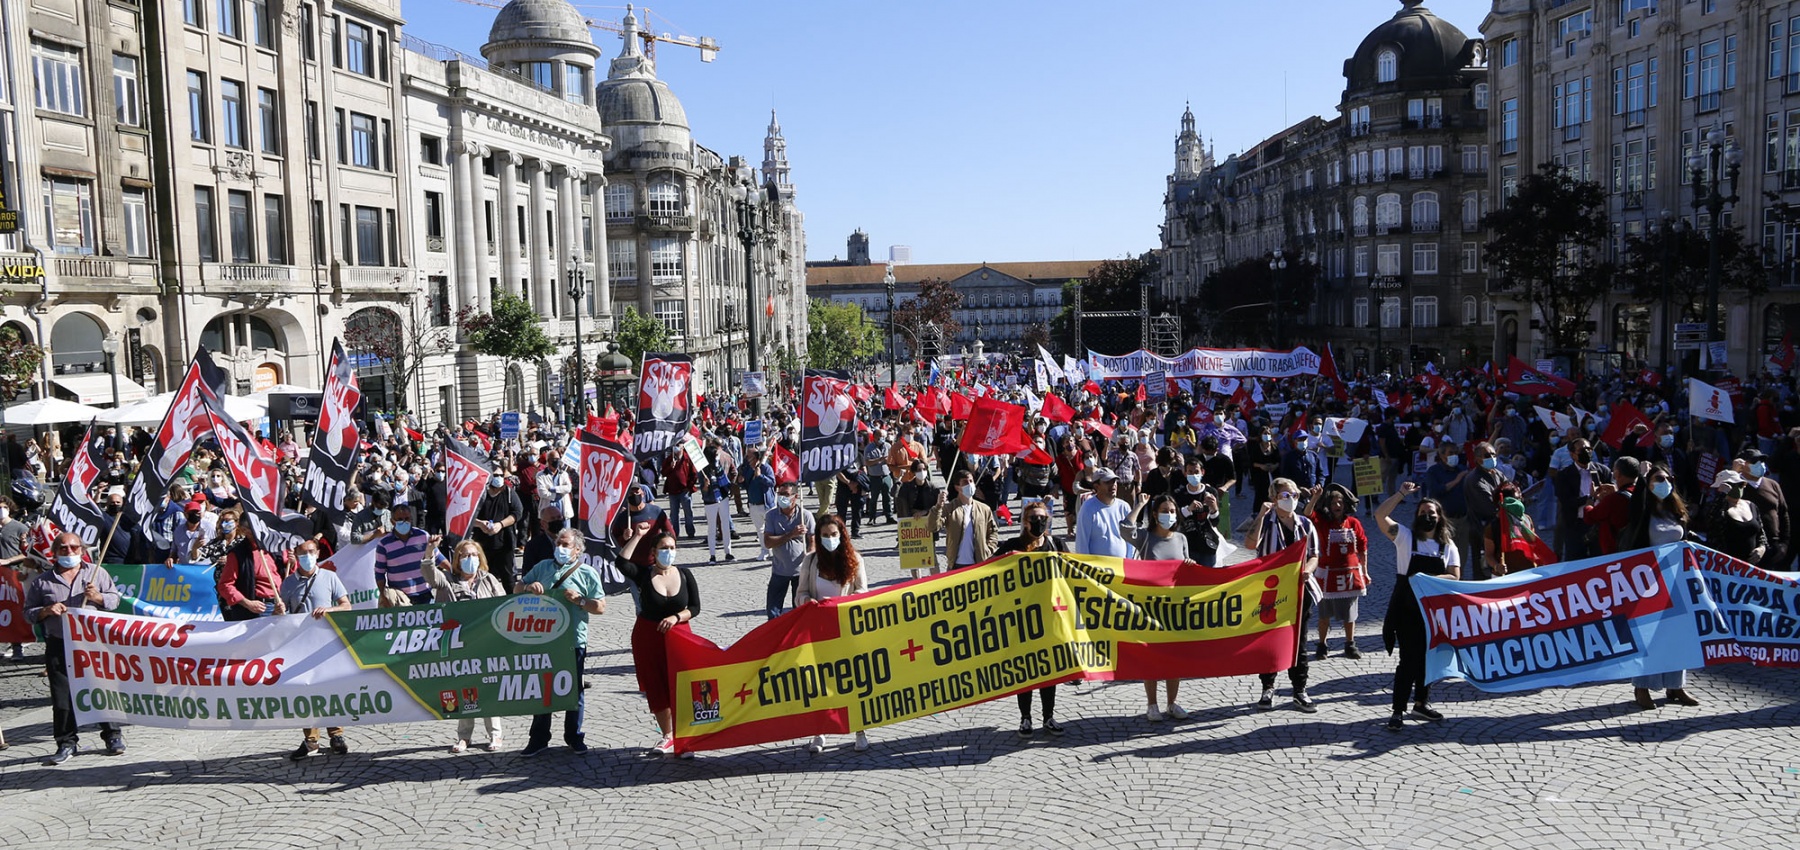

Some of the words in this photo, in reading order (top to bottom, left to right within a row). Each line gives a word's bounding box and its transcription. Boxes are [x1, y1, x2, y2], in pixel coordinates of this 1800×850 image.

[4, 265, 46, 277] VIDA
[1103, 356, 1130, 373] POSTO
[585, 450, 624, 494] STAL
[801, 443, 854, 472] PORTO
[305, 460, 346, 511] PORTO
[52, 493, 98, 546] PORTO
[901, 526, 930, 540] SALÁRIO
[146, 575, 192, 602] Mais
[849, 603, 898, 636] Com
[901, 573, 1000, 622] Coragem
[1003, 568, 1016, 592] e
[1430, 563, 1659, 640] MANIFESTAÇÃO
[1727, 582, 1789, 614] UMA
[69, 612, 196, 648] LUTAMOS
[355, 612, 393, 631] MAIS
[397, 608, 444, 630] FORÇA
[506, 612, 557, 634] lutar
[388, 621, 464, 656] ABRIL
[758, 648, 892, 708] Emprego
[930, 598, 1045, 666] Salário
[1073, 586, 1243, 632] Estabilidade
[1458, 620, 1634, 680] NACIONAL
[1706, 643, 1742, 660] MAIS
[72, 650, 145, 682] PELOS
[149, 656, 285, 686] DIREITOS
[408, 658, 482, 680] AVANÇAR
[487, 656, 510, 672] NA
[514, 653, 552, 670] LUTA
[75, 687, 210, 720] COMBATEMOS
[216, 698, 232, 720] A
[240, 685, 394, 721] EXPLORAÇÃO
[442, 690, 454, 700] STAL
[482, 675, 498, 684] em
[498, 670, 573, 708] MAIO
[859, 687, 918, 726] LUTAR
[918, 671, 975, 710] PELOS
[976, 648, 1052, 695] NOSSOS
[694, 710, 719, 720] CGTP
